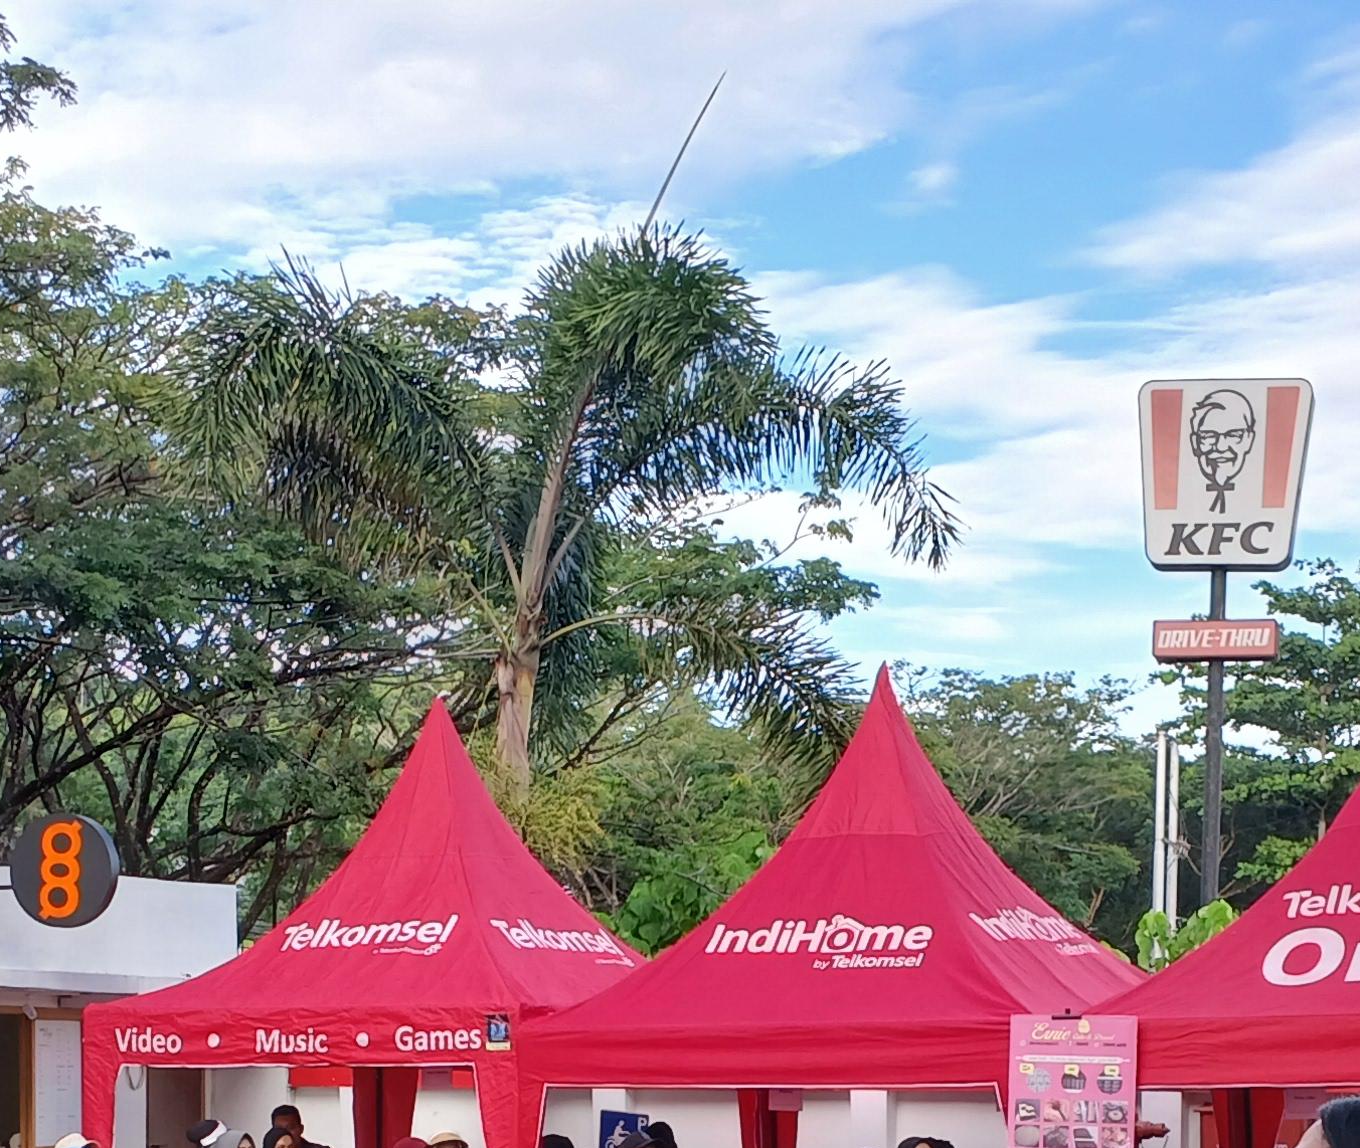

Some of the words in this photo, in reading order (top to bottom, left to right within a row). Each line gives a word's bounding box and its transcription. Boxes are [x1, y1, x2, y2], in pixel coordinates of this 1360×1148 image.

[1164, 521, 1274, 556] KFC
[1157, 627, 1271, 649] DRIVE-THRU
[280, 914, 460, 951] Telkomsel
[489, 918, 626, 957] Telkomsel
[704, 914, 934, 955] IndiHome
[812, 958, 830, 970] by
[831, 953, 924, 969] Telkomsel
[115, 1028, 183, 1053] Video
[255, 1028, 329, 1054] Music
[393, 1025, 482, 1052] Games
